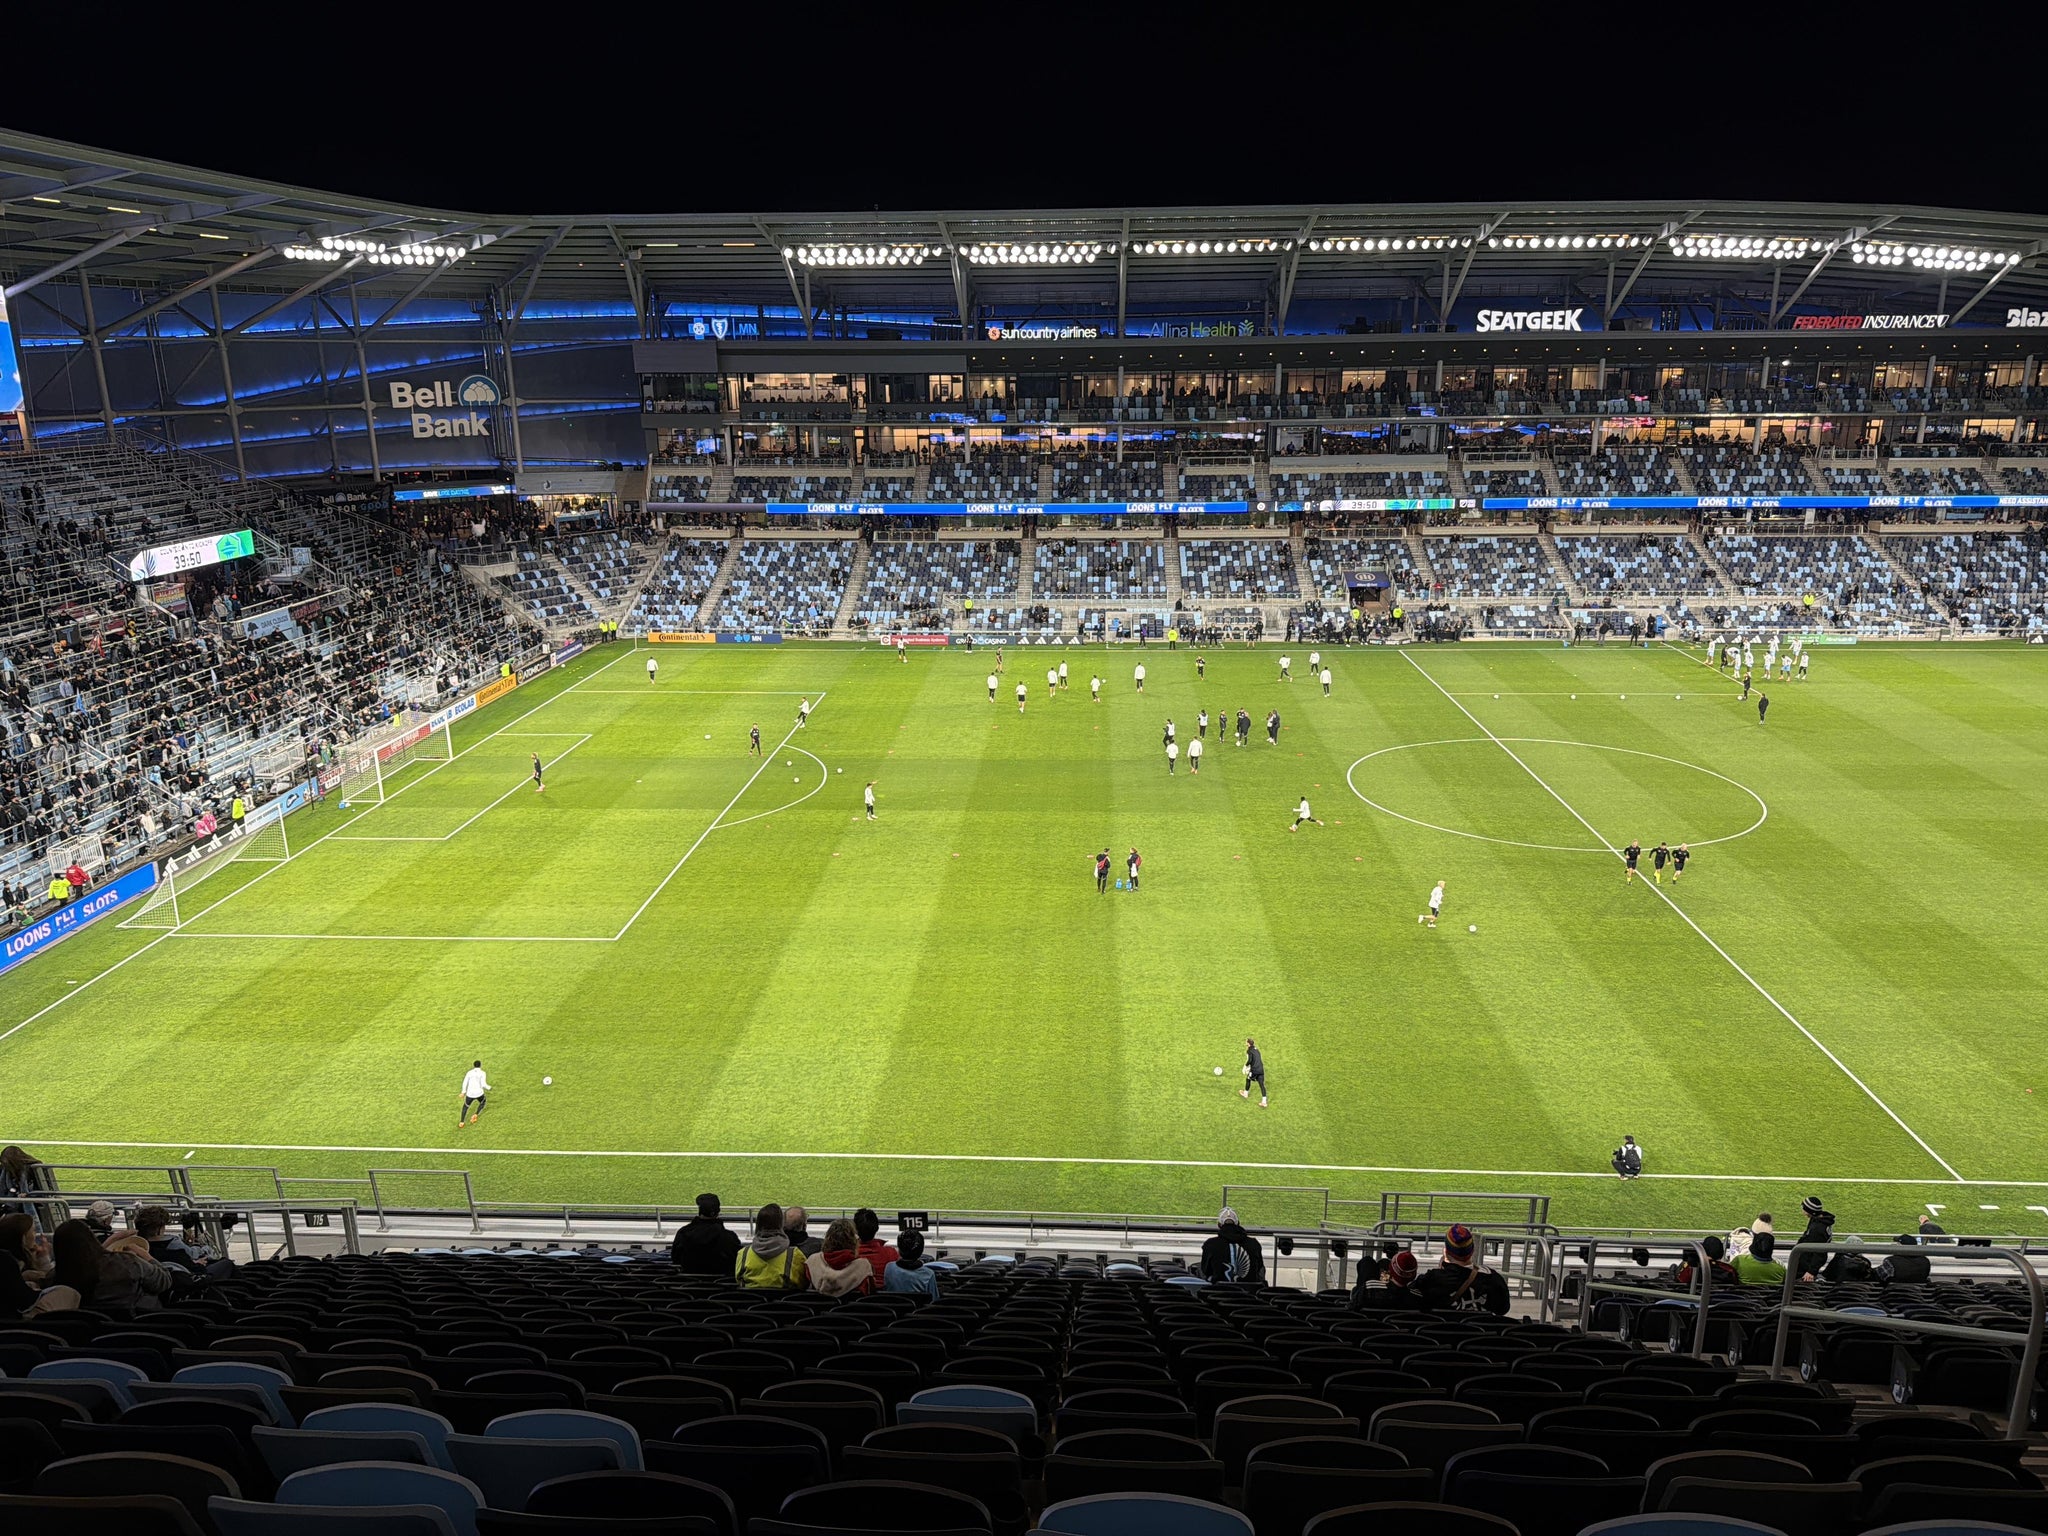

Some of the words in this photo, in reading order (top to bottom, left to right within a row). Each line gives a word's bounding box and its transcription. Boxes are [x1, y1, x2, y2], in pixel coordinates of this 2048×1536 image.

[1476, 308, 1583, 332] SEATGEEK
[1793, 315, 1863, 329] FEDERATED
[1862, 314, 1937, 329] INSURANCE
[739, 323, 758, 335] MN
[1060, 326, 1097, 339] airlines
[1149, 322, 1188, 338] Allina
[1190, 320, 1236, 338] Health
[389, 381, 453, 408] Bell
[411, 411, 490, 438] Bank
[346, 492, 367, 502] Bank
[1697, 498, 1728, 507] LOONS
[1869, 497, 1900, 506] LOONS
[360, 501, 389, 511] GOOD
[807, 504, 836, 513] LOONS
[966, 504, 995, 512] LOONS
[1126, 503, 1155, 512] LOONS
[1351, 501, 1377, 509] 39:50
[1527, 499, 1558, 508] LOONS
[173, 551, 202, 570] 39:50
[658, 633, 699, 641] Continental
[479, 683, 502, 703] Continental
[504, 679, 515, 690] Tire
[454, 697, 475, 715] ECOLAB
[326, 777, 341, 788] TIRE
[6, 922, 51, 957] LOONS
[82, 889, 118, 918] SLOTS
[313, 1214, 324, 1226] 115
[903, 1216, 923, 1228] 115
